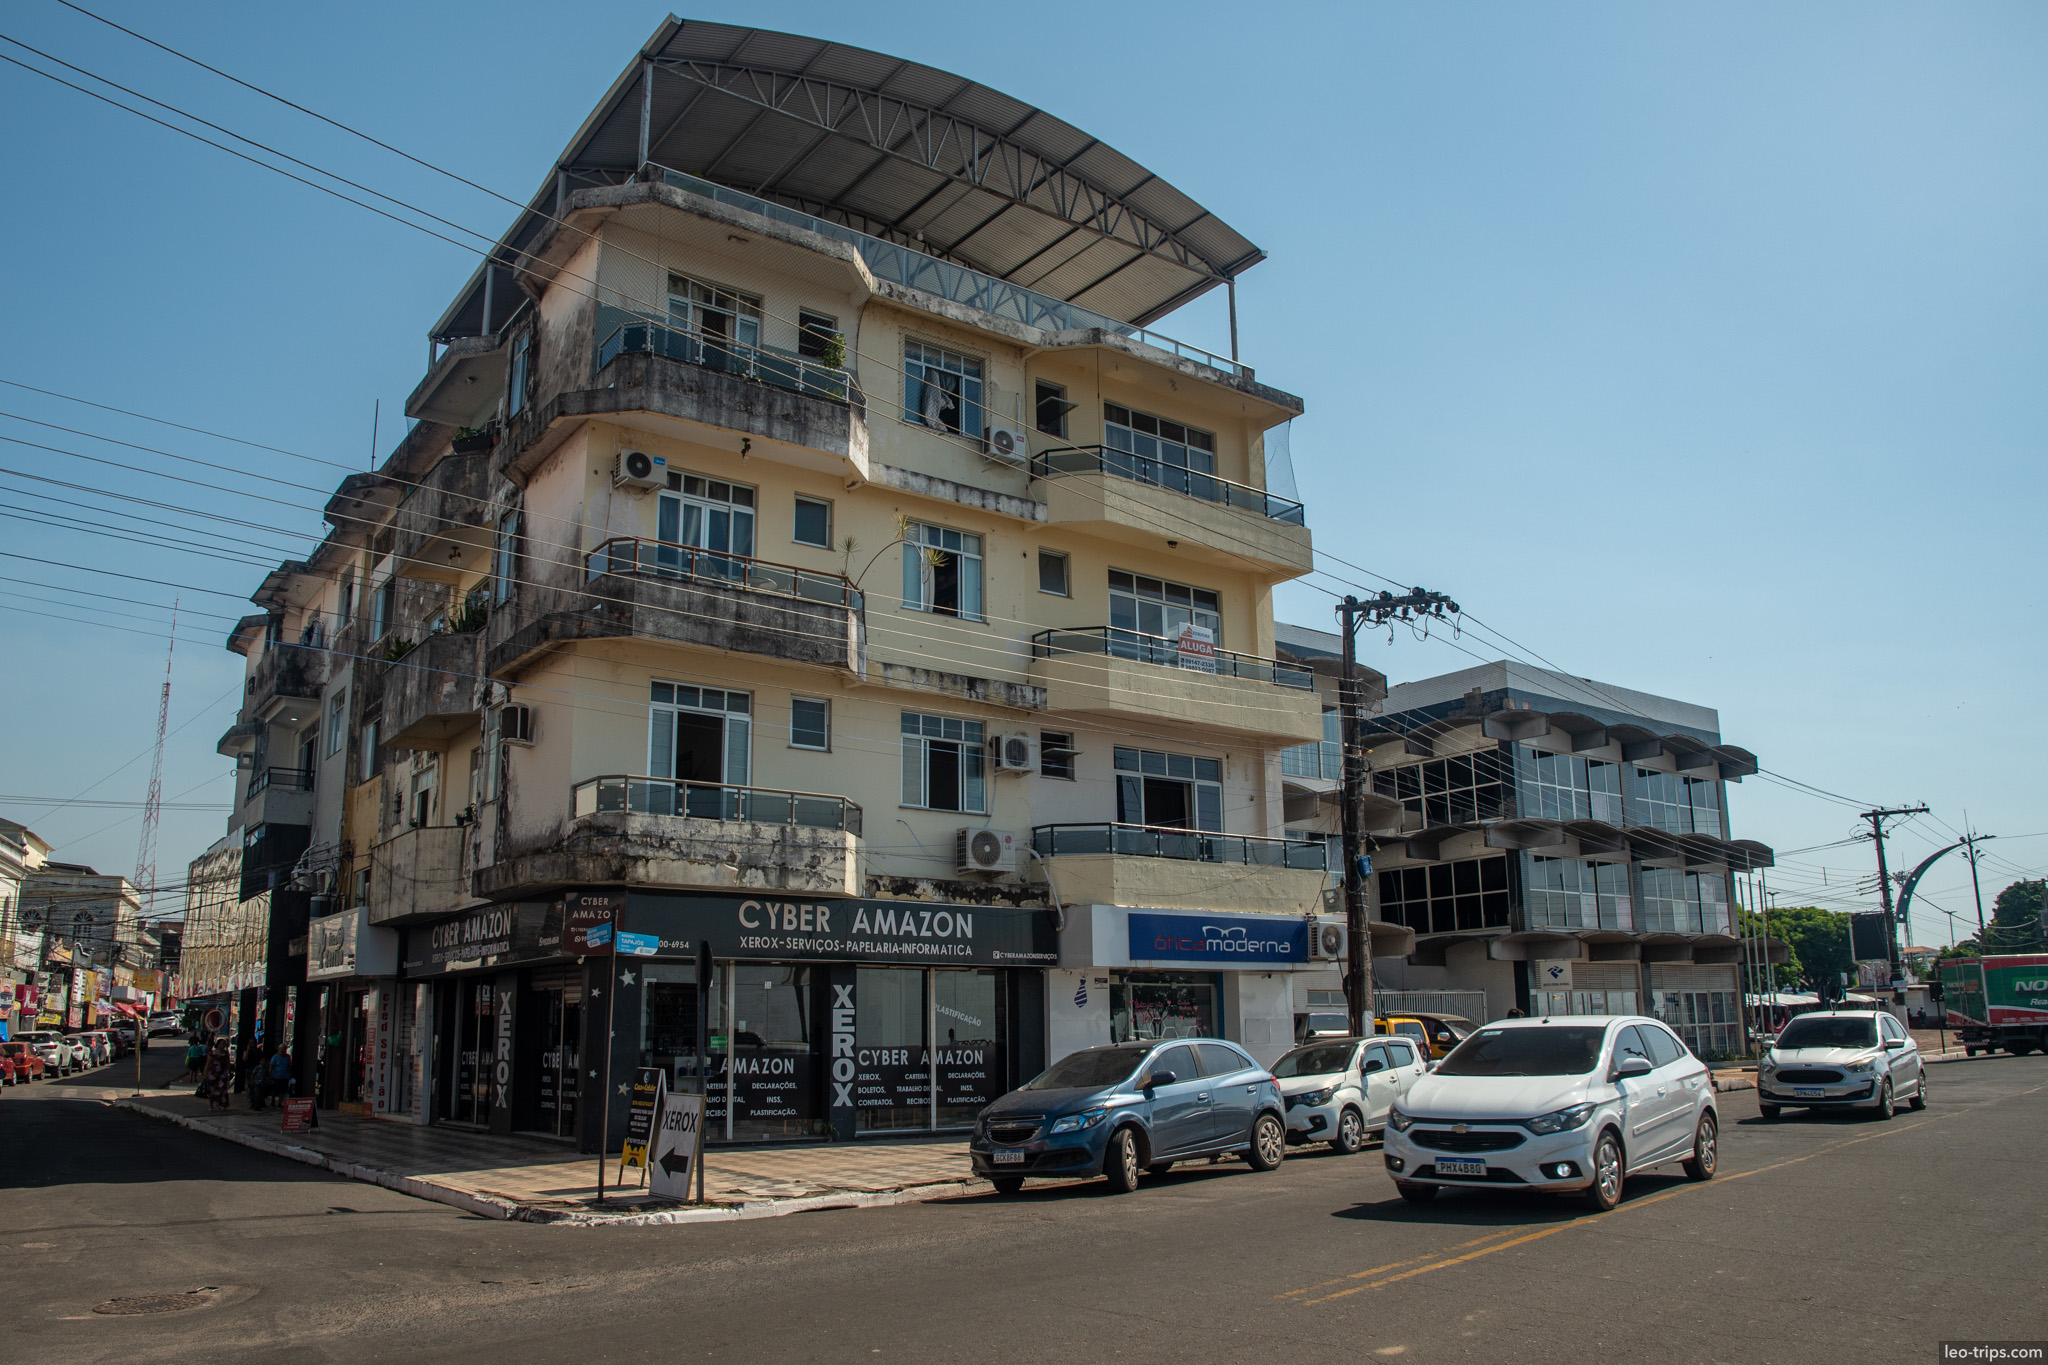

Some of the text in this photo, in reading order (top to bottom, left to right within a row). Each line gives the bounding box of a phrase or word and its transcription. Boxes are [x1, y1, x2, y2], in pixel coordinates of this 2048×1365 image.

[1181, 640, 1213, 654] ALUGA
[581, 897, 608, 906] CYBER
[572, 910, 612, 919] AMAZO
[738, 901, 973, 938] CYBER AMAZON
[432, 909, 511, 949] CYBER AMAZON
[495, 991, 512, 1108] XEROX
[832, 984, 856, 1107] XEROX
[542, 1052, 560, 1068] CYBE
[720, 1058, 794, 1074] AMAZON
[858, 1050, 983, 1066] CYBER AMAZON
[705, 1109, 727, 1117] ECIBO
[662, 1110, 699, 1133] XEROX
[1440, 1162, 1481, 1174] PHX4B80
